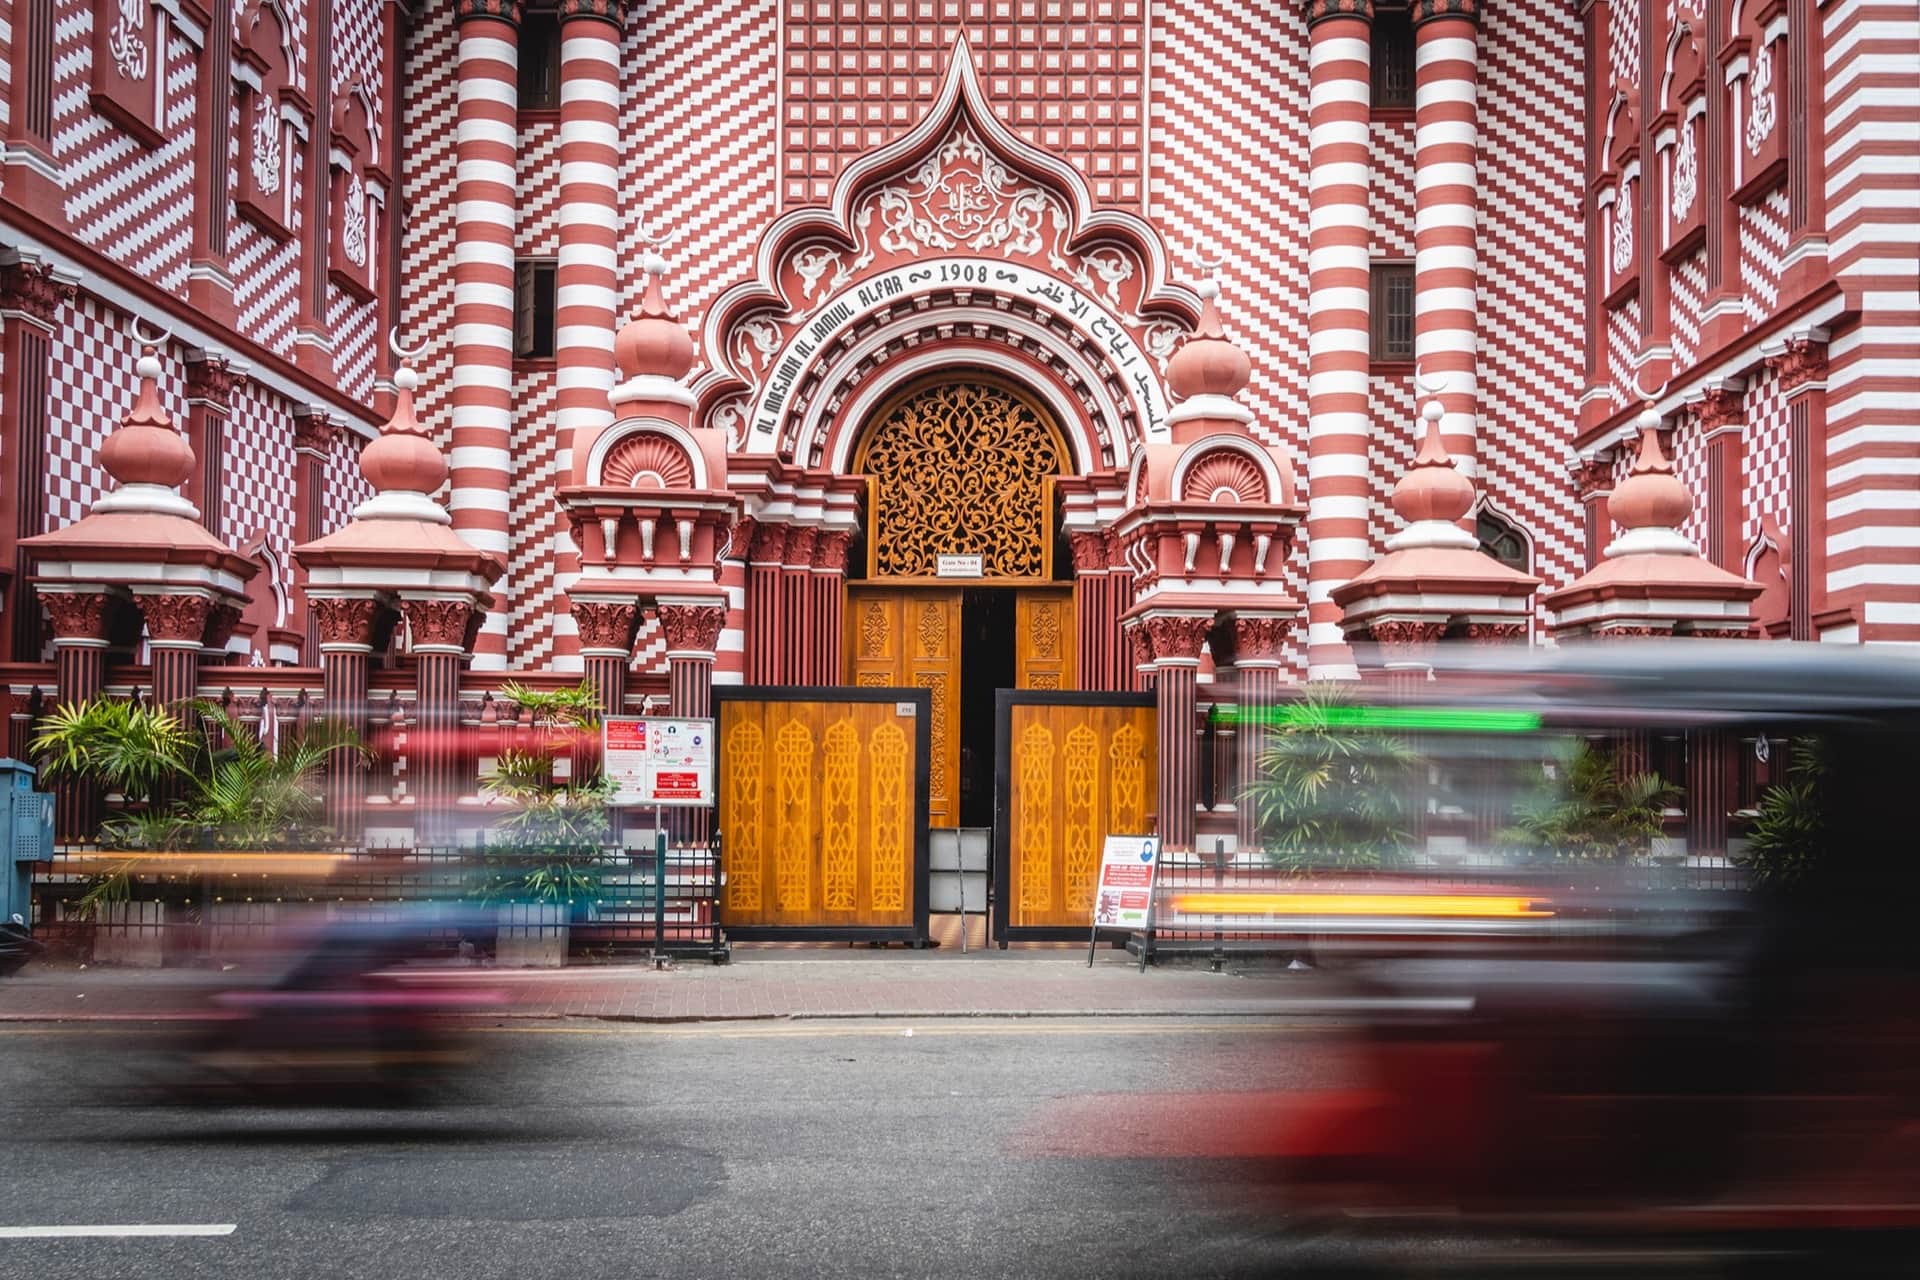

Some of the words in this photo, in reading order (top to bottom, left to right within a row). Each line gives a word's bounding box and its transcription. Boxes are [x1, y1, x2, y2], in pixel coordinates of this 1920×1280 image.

[857, 275, 904, 308] ALFAR
[940, 263, 988, 284] 1908
[809, 301, 856, 344] JAMIUL
[1091, 316, 1138, 367] الجامع
[794, 339, 816, 359] AL
[763, 355, 804, 415] MASJIDH
[1134, 371, 1167, 434] المسجد
[756, 418, 776, 435] AL
